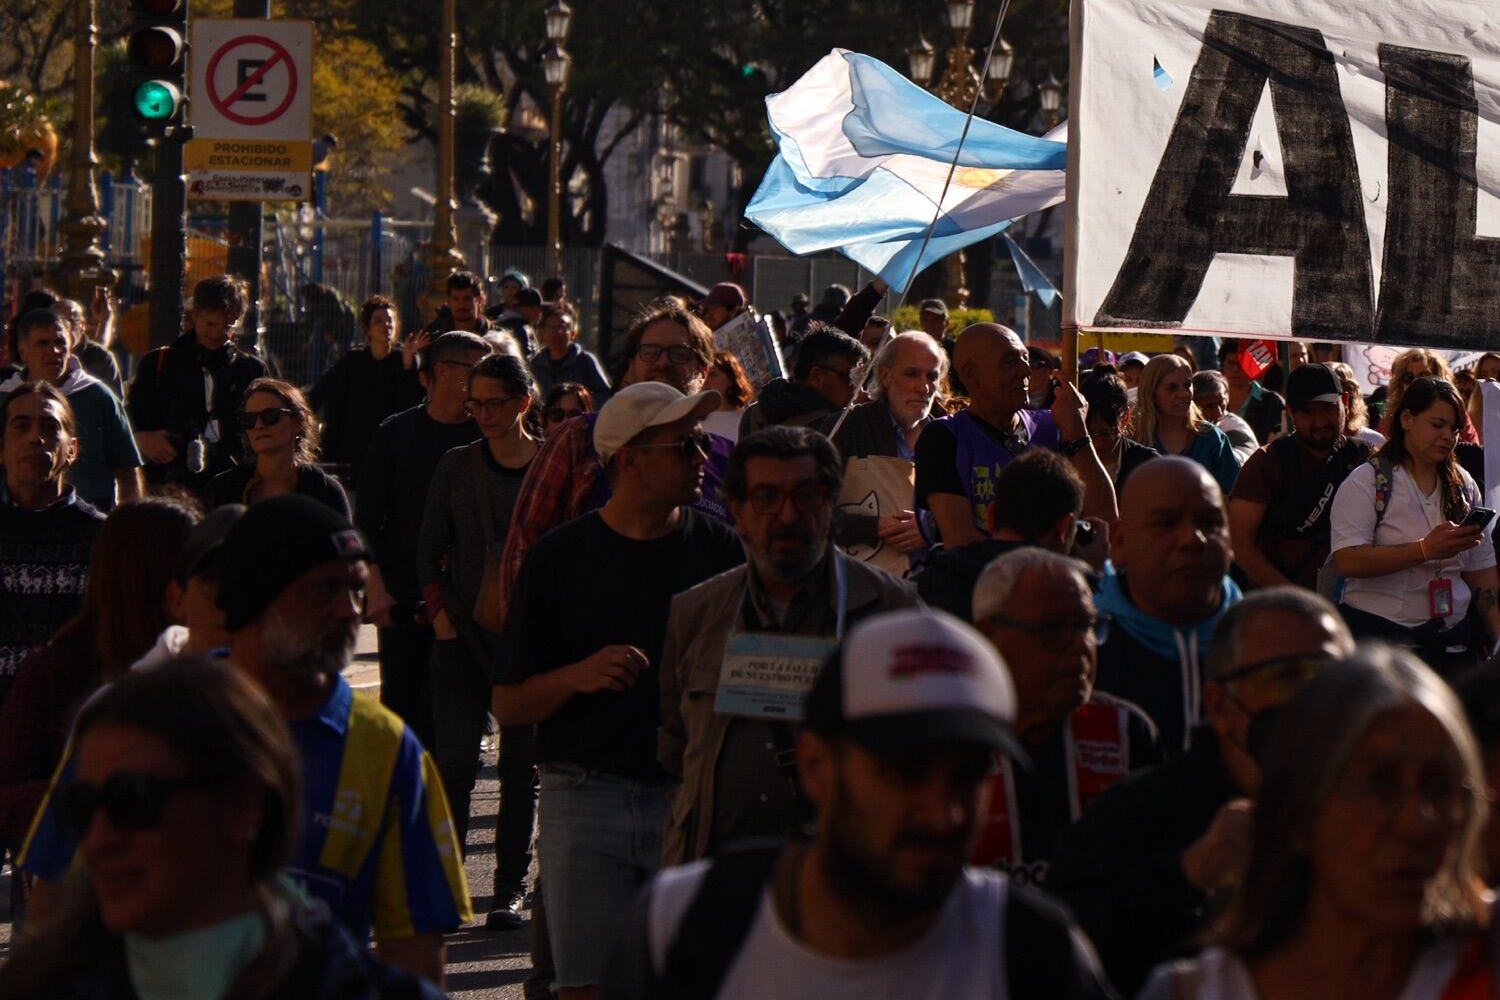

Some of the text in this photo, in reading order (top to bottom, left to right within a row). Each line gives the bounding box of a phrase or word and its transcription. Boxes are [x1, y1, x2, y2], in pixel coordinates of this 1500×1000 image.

[213, 143, 286, 155] PROHIBIDO
[208, 155, 291, 167] ESTACIONAR
[1296, 482, 1334, 533] HEAD
[748, 661, 769, 671] POR
